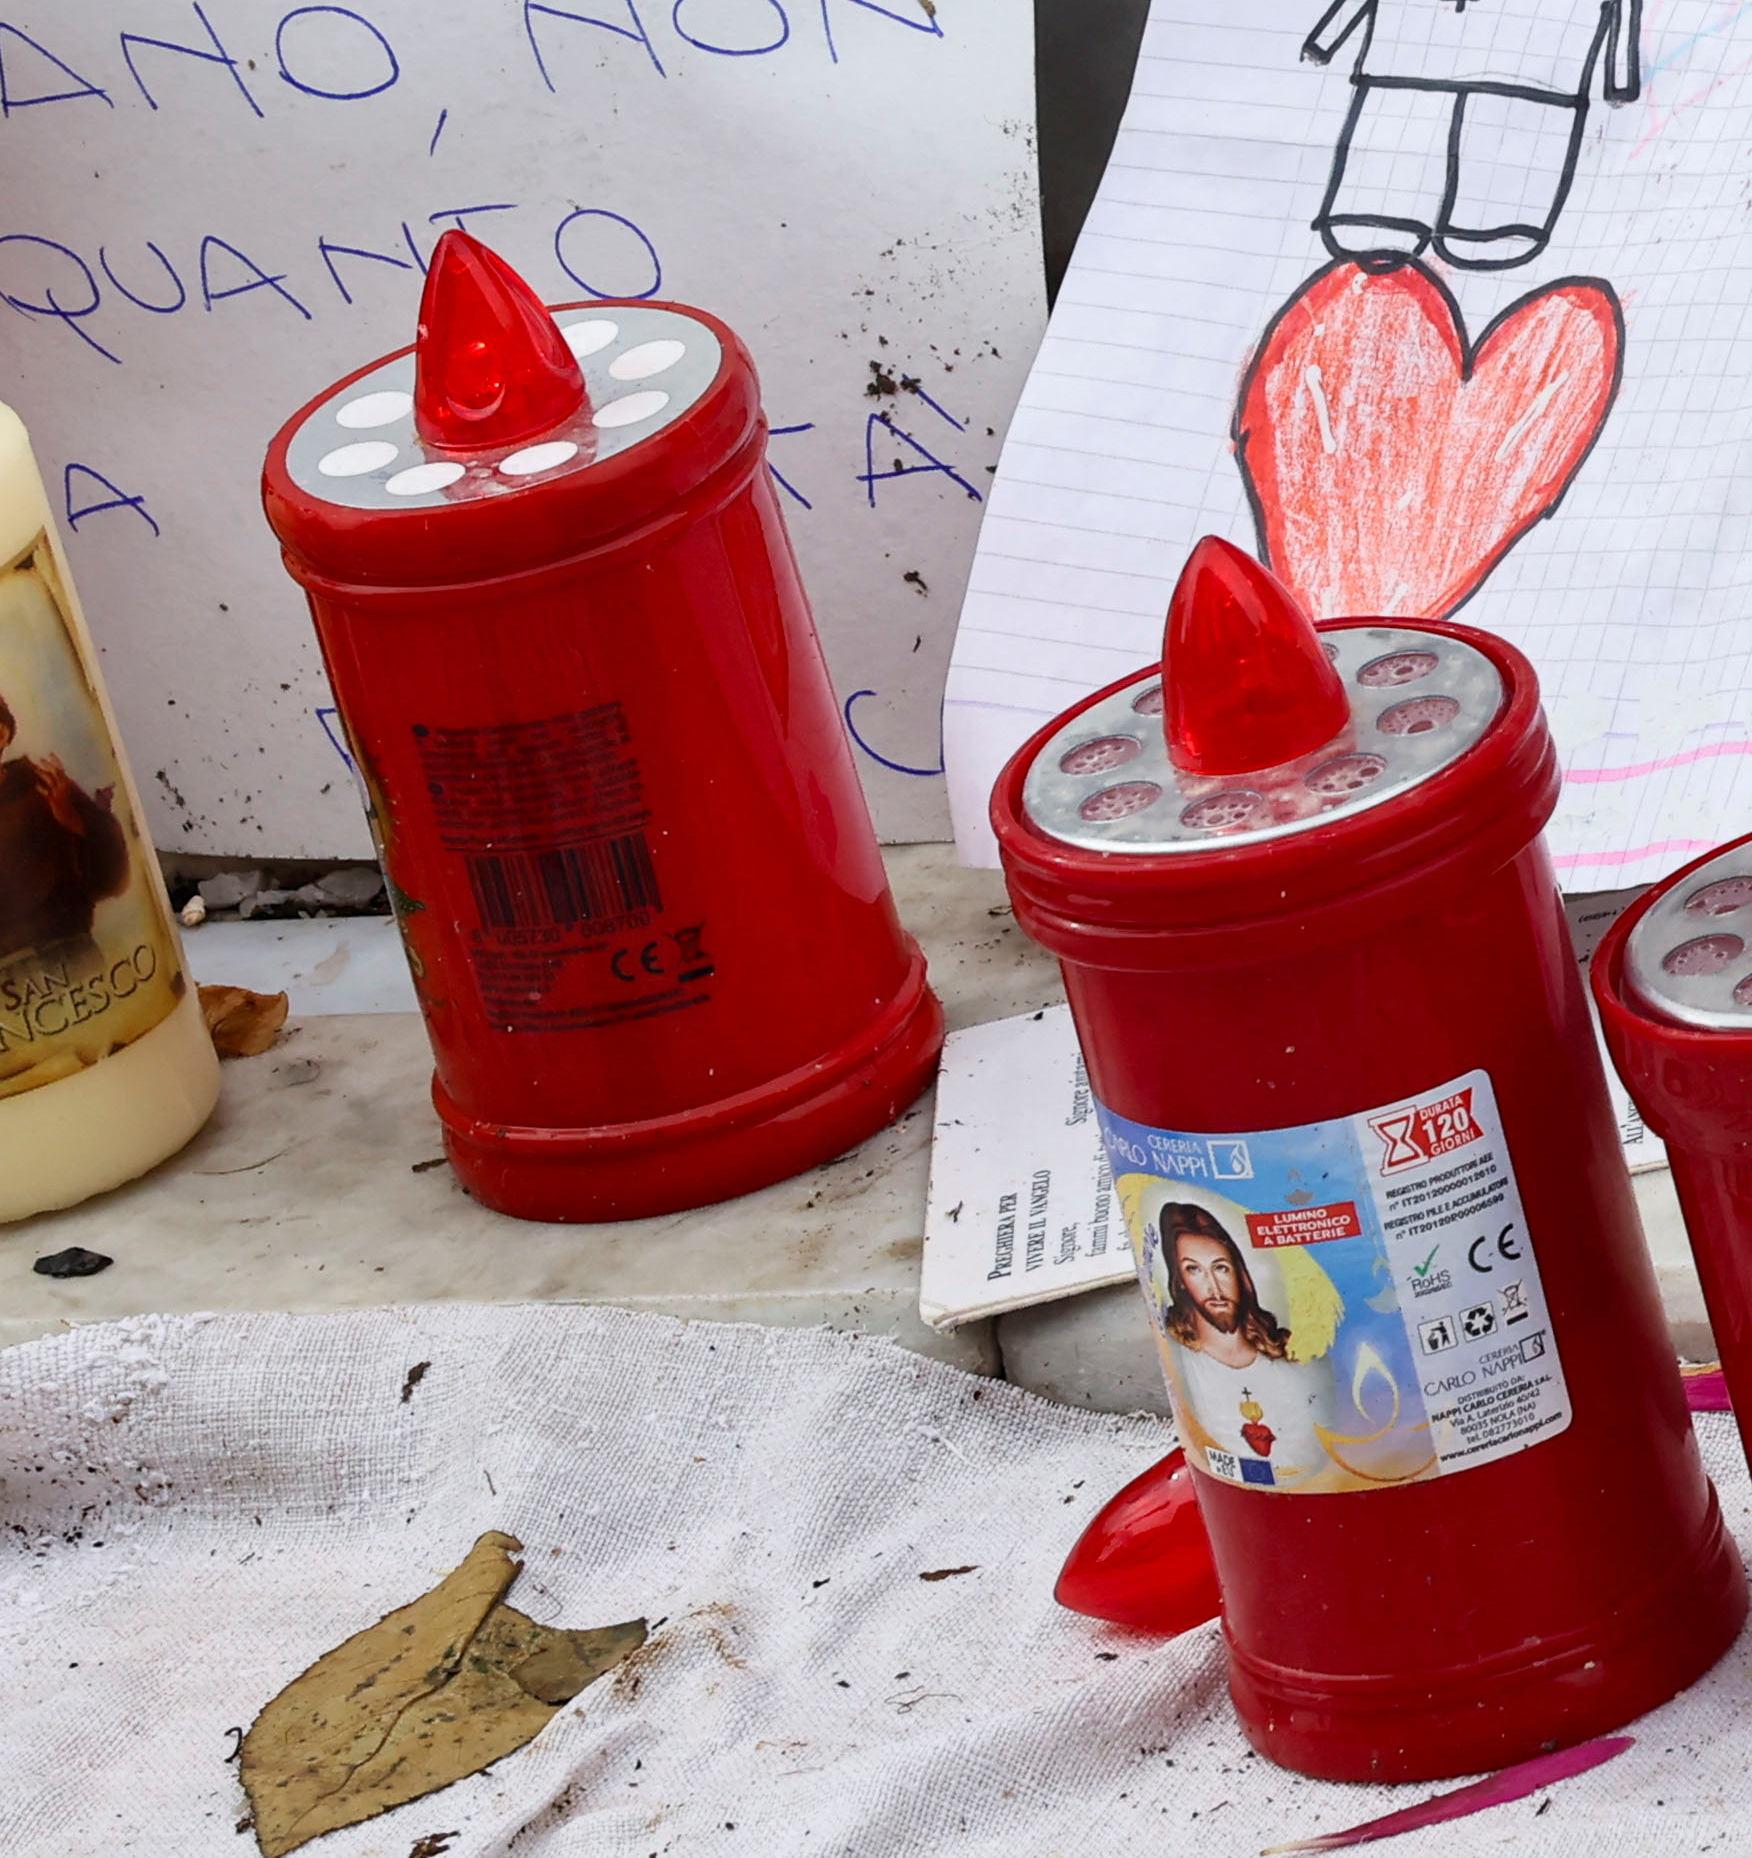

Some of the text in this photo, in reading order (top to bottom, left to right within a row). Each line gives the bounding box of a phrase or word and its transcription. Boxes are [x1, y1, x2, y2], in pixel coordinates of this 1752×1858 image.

[1, 963, 69, 1012] SAN
[1419, 1094, 1464, 1121] DURATA
[1422, 1106, 1469, 1144] 120
[1430, 1128, 1476, 1156] GIORNI
[1152, 1151, 1209, 1178] NAPPI
[1386, 1179, 1428, 1200] REGISTRO
[1025, 1169, 1051, 1272] VIVERE IL VANGELO
[1256, 1215, 1352, 1236] ELETTRONICO
[1273, 1209, 1328, 1225] LUMINO
[1384, 1211, 1426, 1231] REGISTRO
[987, 1193, 1018, 1281] PREGHIERA PER
[1263, 1227, 1346, 1246] A BATTERIE
[1411, 1269, 1451, 1292] RoHS
[1423, 1352, 1523, 1397] CARLO NAPPI
[1431, 1407, 1462, 1423] NAPPI
[1463, 1396, 1495, 1413] CARLO
[1495, 1380, 1533, 1401] CERERIA
[1458, 1379, 1510, 1405] DISTRIBUITO
[1489, 1409, 1516, 1426] NOLA
[1209, 1449, 1236, 1466] MADE
